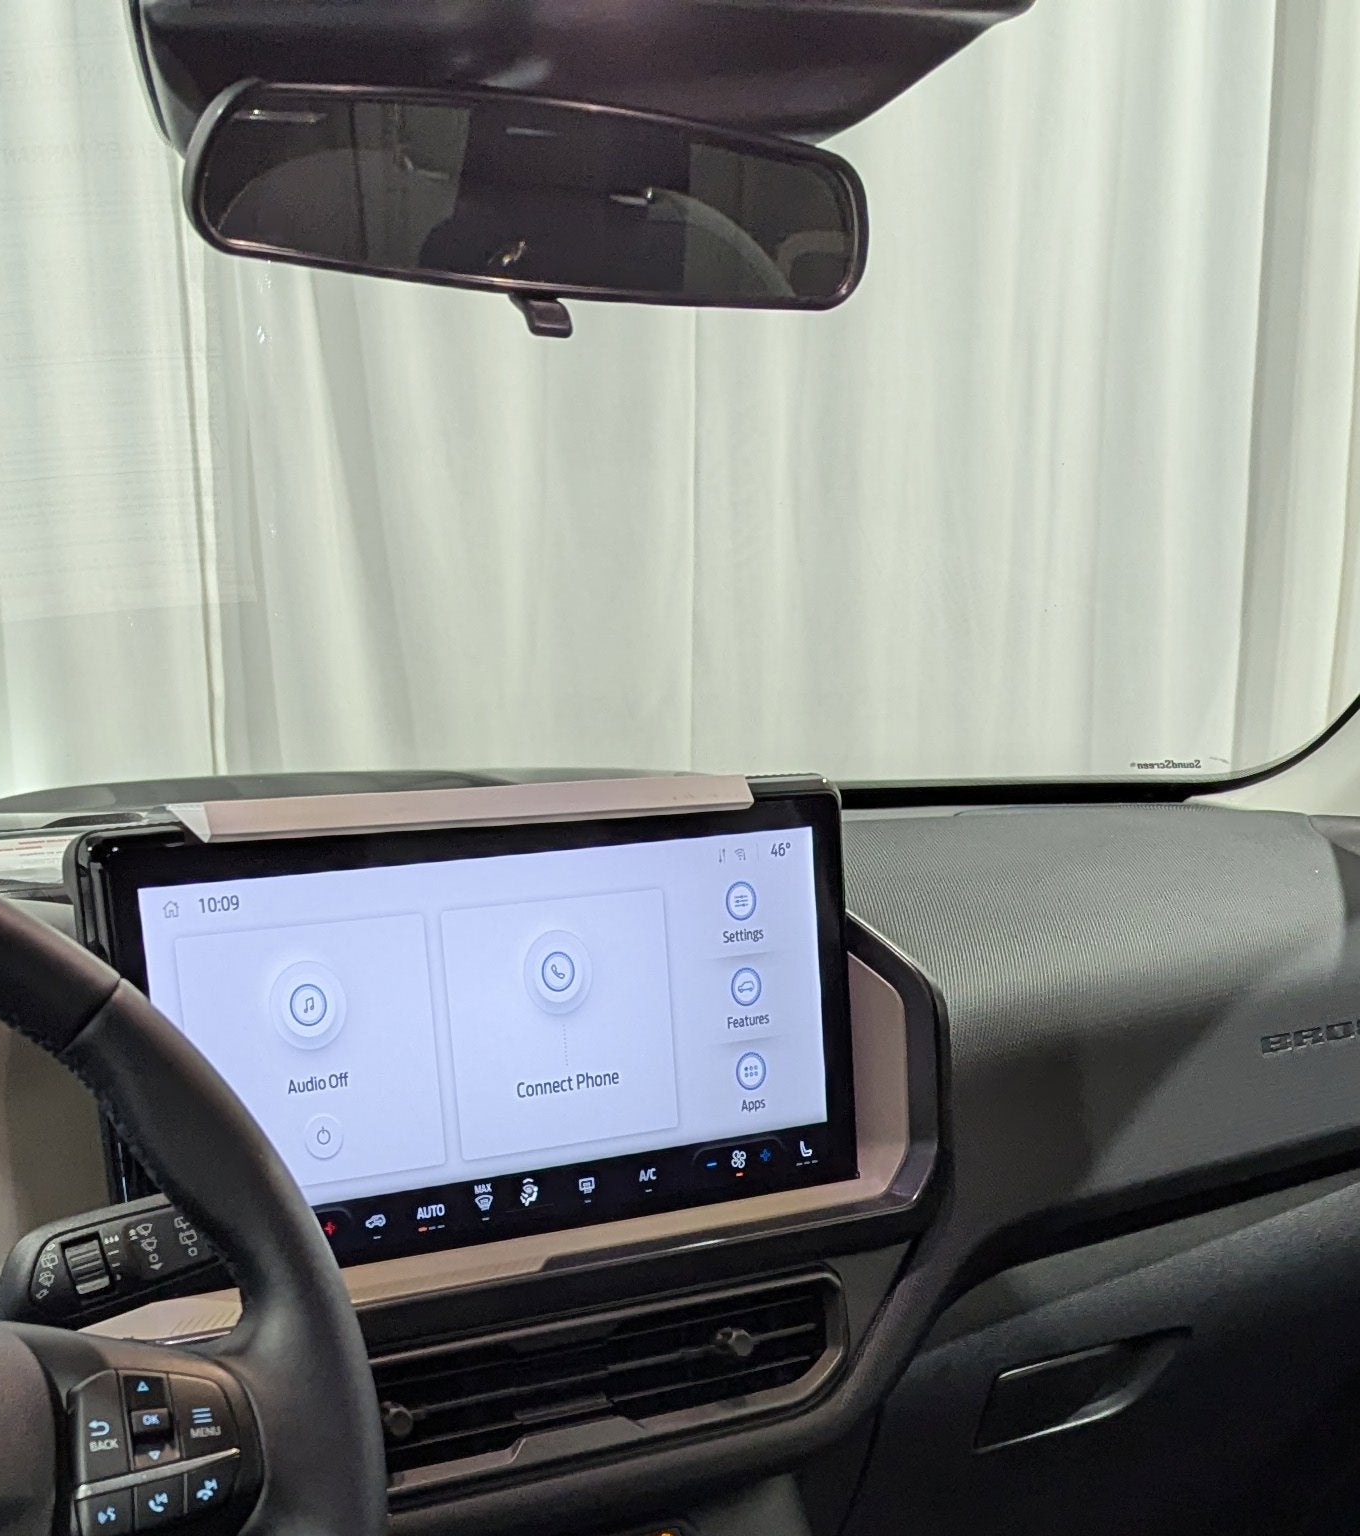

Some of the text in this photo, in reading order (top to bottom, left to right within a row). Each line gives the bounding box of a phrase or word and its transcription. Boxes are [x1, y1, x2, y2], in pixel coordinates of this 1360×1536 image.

[198, 895, 240, 914] 10:09
[722, 928, 764, 943] Settings
[727, 1014, 770, 1029] Features
[287, 1071, 349, 1095] Audio Off
[516, 1070, 620, 1099] Connect Phone
[741, 1099, 766, 1112] Apps
[639, 1167, 658, 1183] A/C
[473, 1183, 492, 1194] MAX
[416, 1203, 446, 1220] AUTO
[142, 1414, 160, 1426] OK
[190, 1425, 222, 1439] MENU
[89, 1438, 119, 1452] BACK
